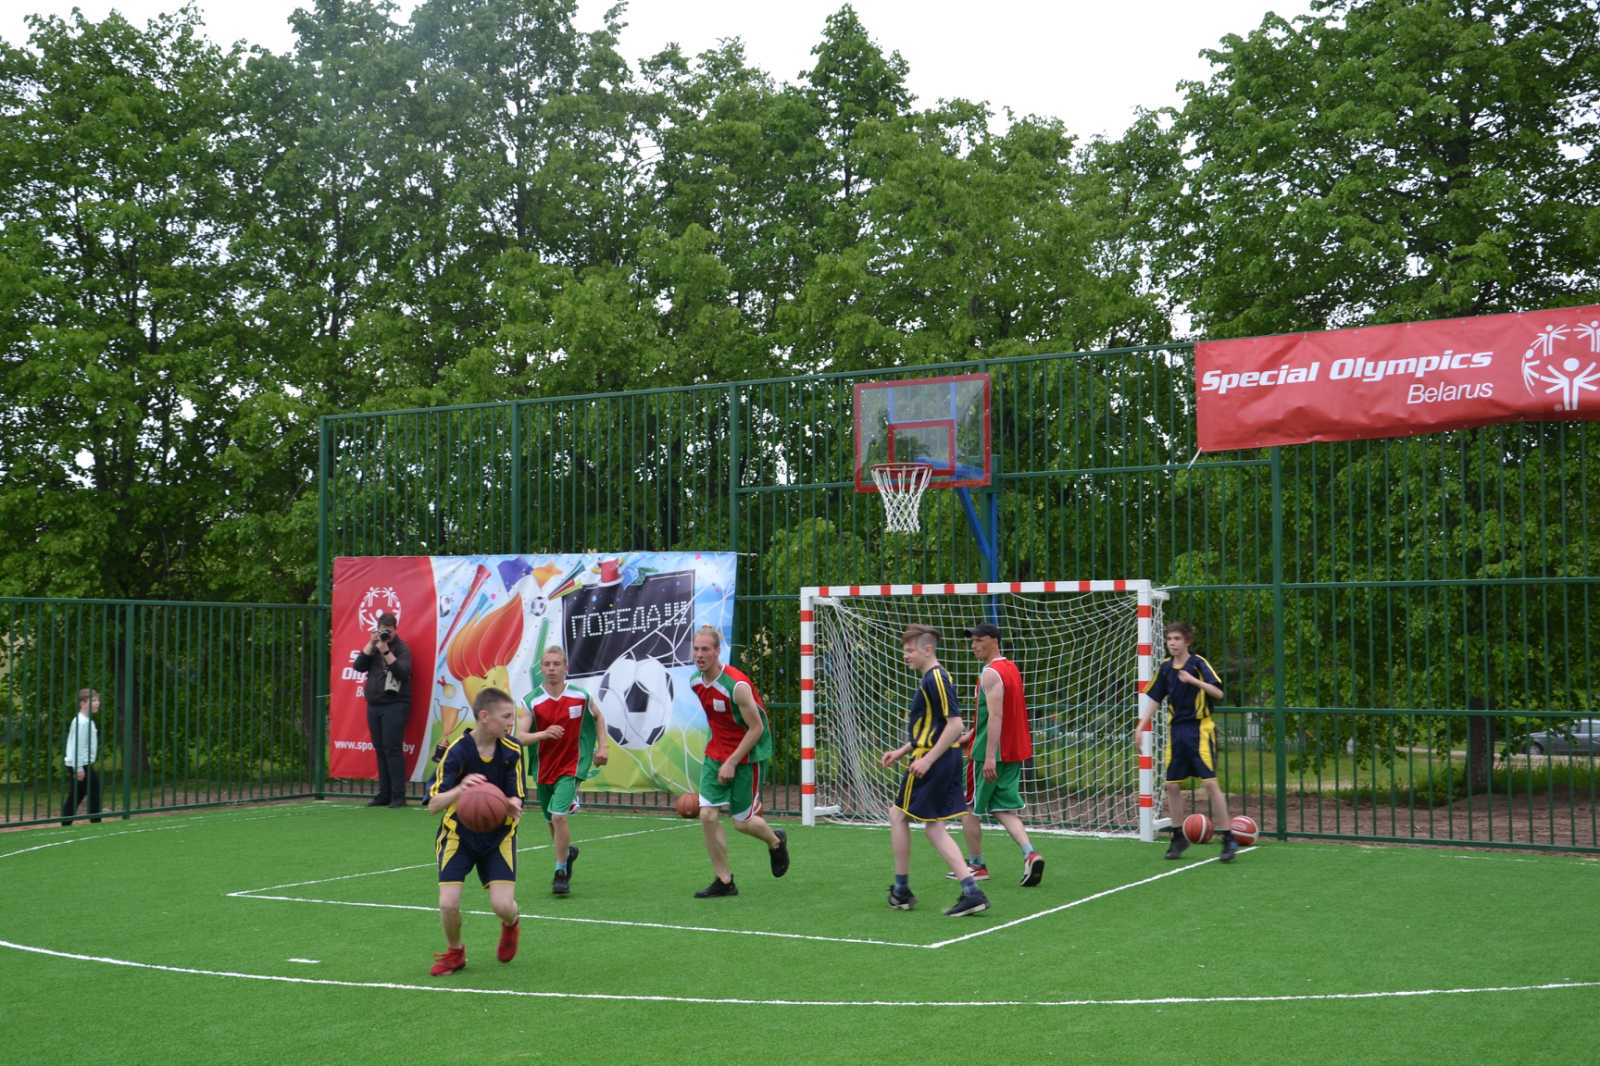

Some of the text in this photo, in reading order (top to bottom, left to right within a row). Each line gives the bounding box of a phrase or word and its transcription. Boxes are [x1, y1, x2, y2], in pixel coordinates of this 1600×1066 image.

[1201, 349, 1494, 395] Special Olympics
[1407, 382, 1494, 406] Belarus
